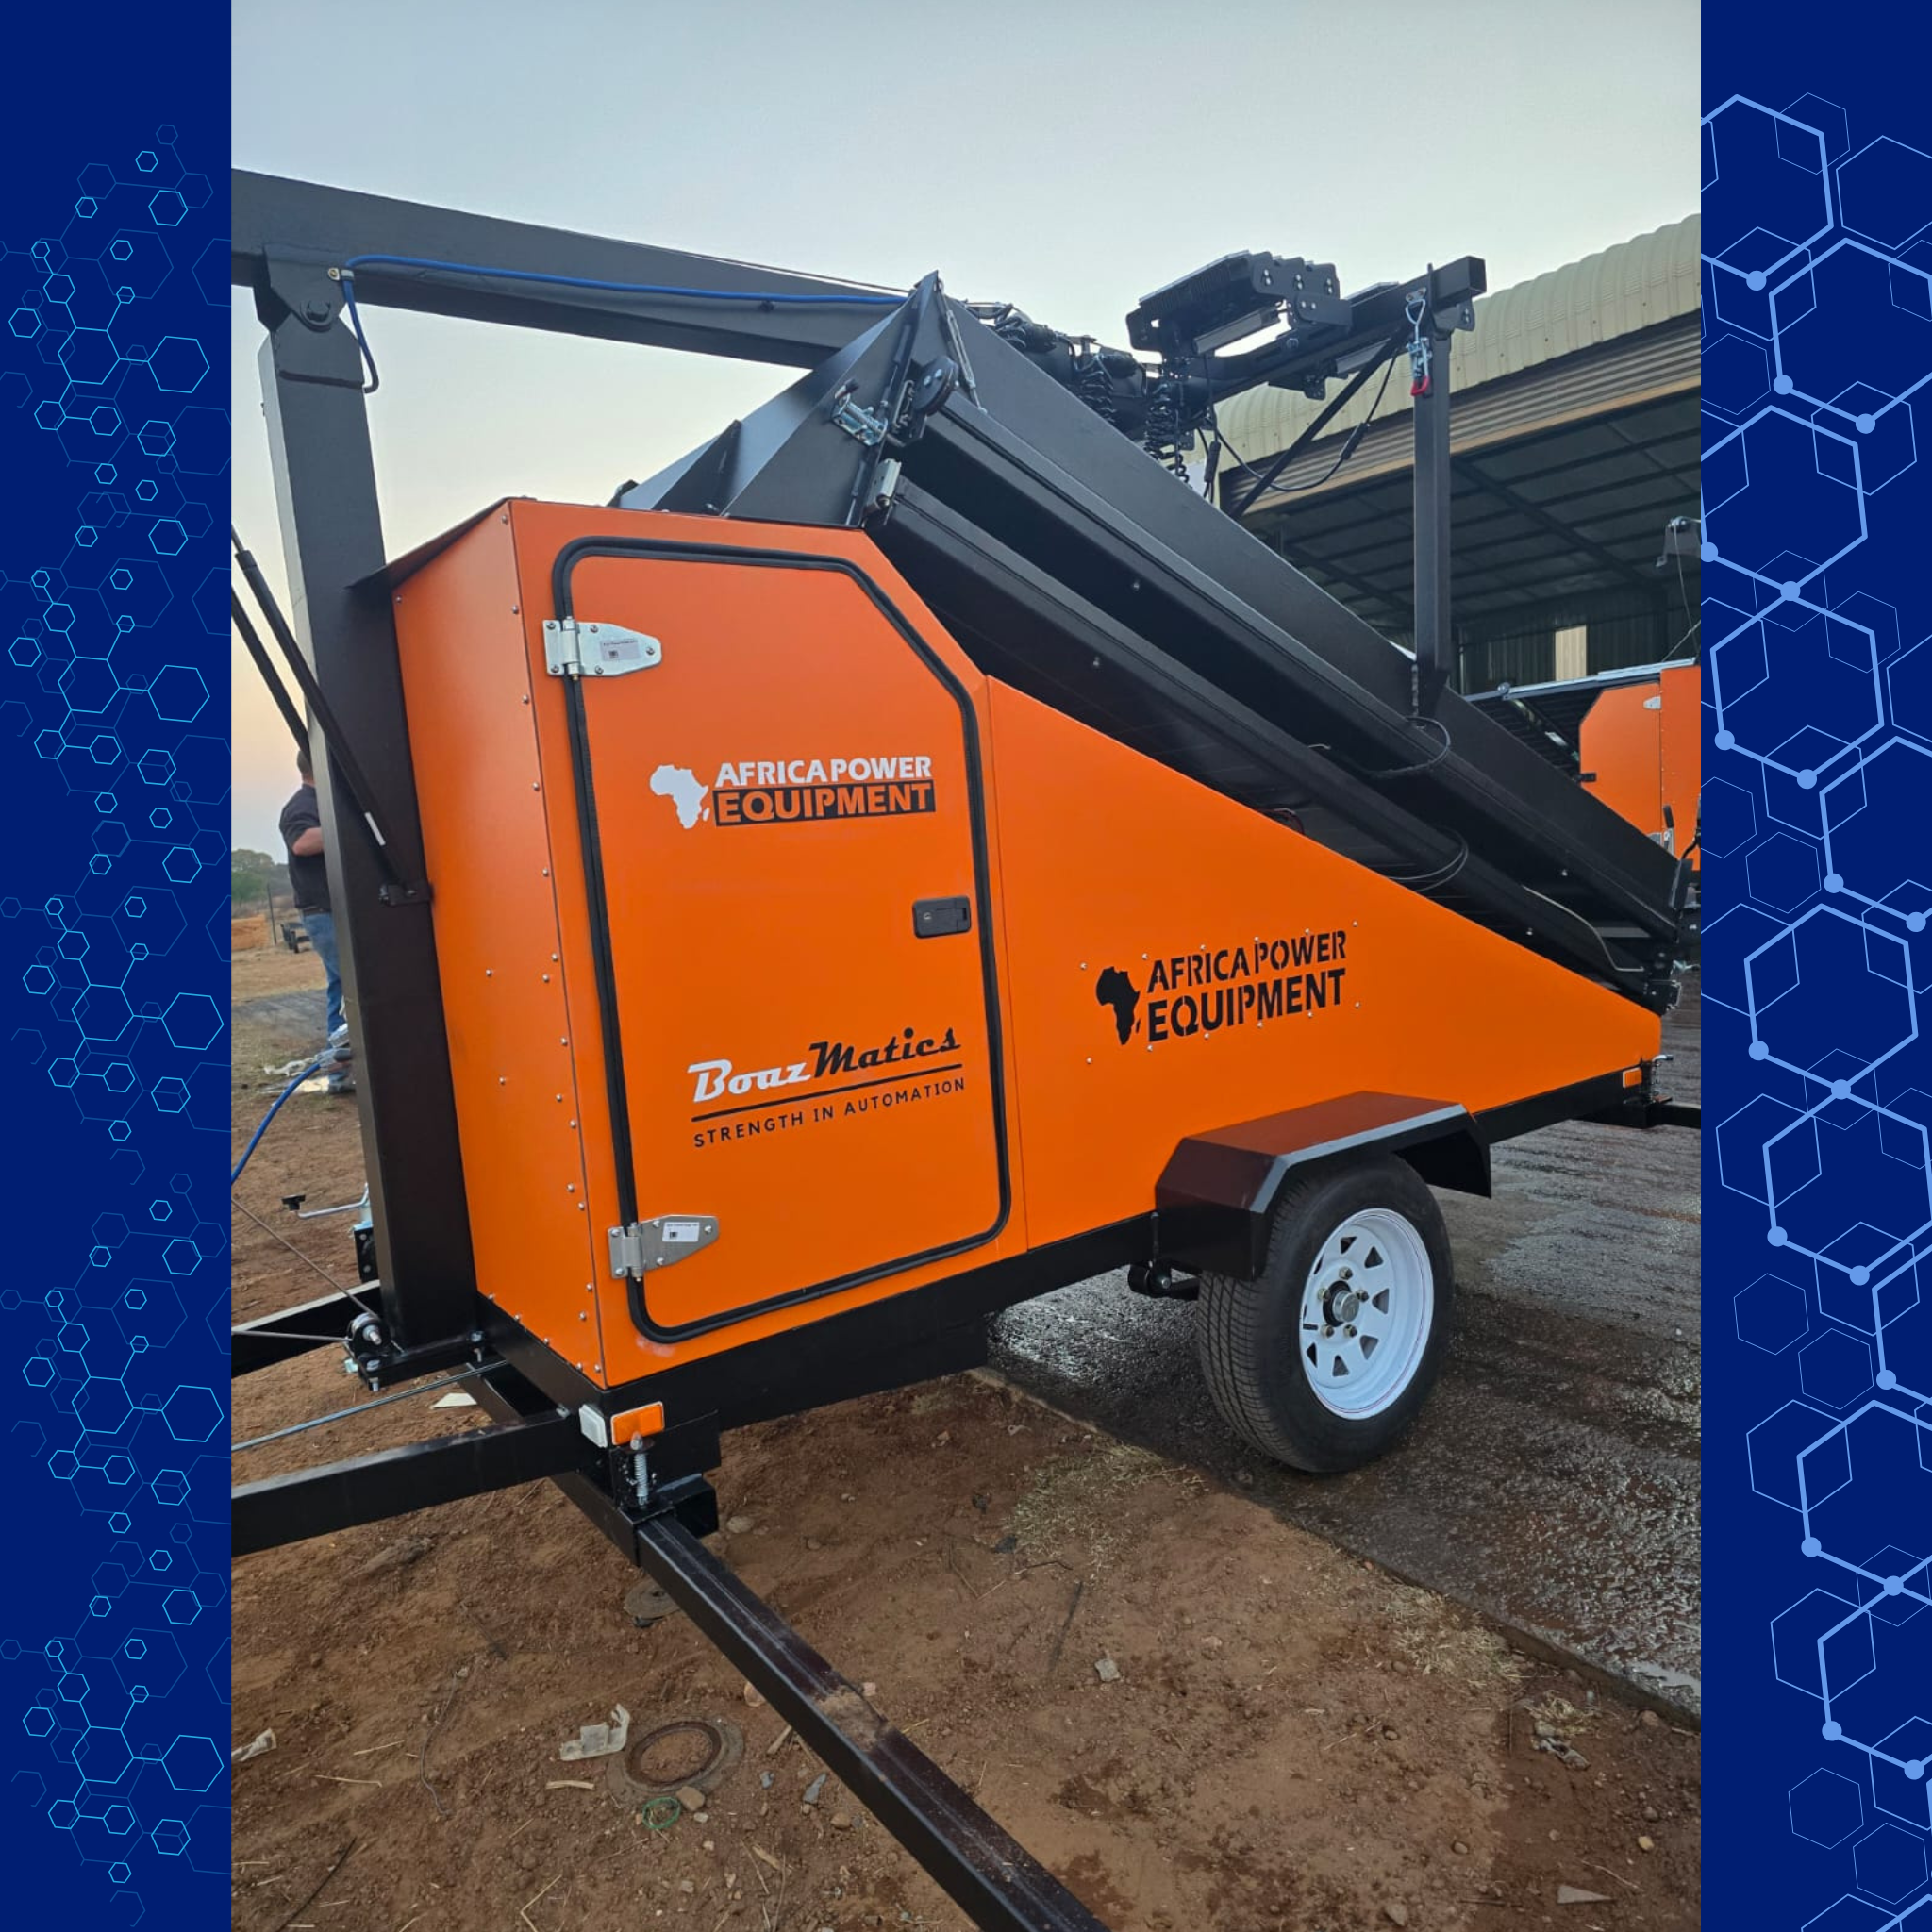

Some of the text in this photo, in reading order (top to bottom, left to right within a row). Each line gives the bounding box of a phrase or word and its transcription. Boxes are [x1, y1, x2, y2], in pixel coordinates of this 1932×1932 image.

[715, 756, 932, 787] AFRICA POWER
[717, 783, 932, 824] EQUIPMENT
[1147, 930, 1347, 993] AFRICA POWER
[1147, 968, 1346, 1041] EQUIPMENT
[694, 1077, 966, 1147] STRENGTH IN AUTOMATION
